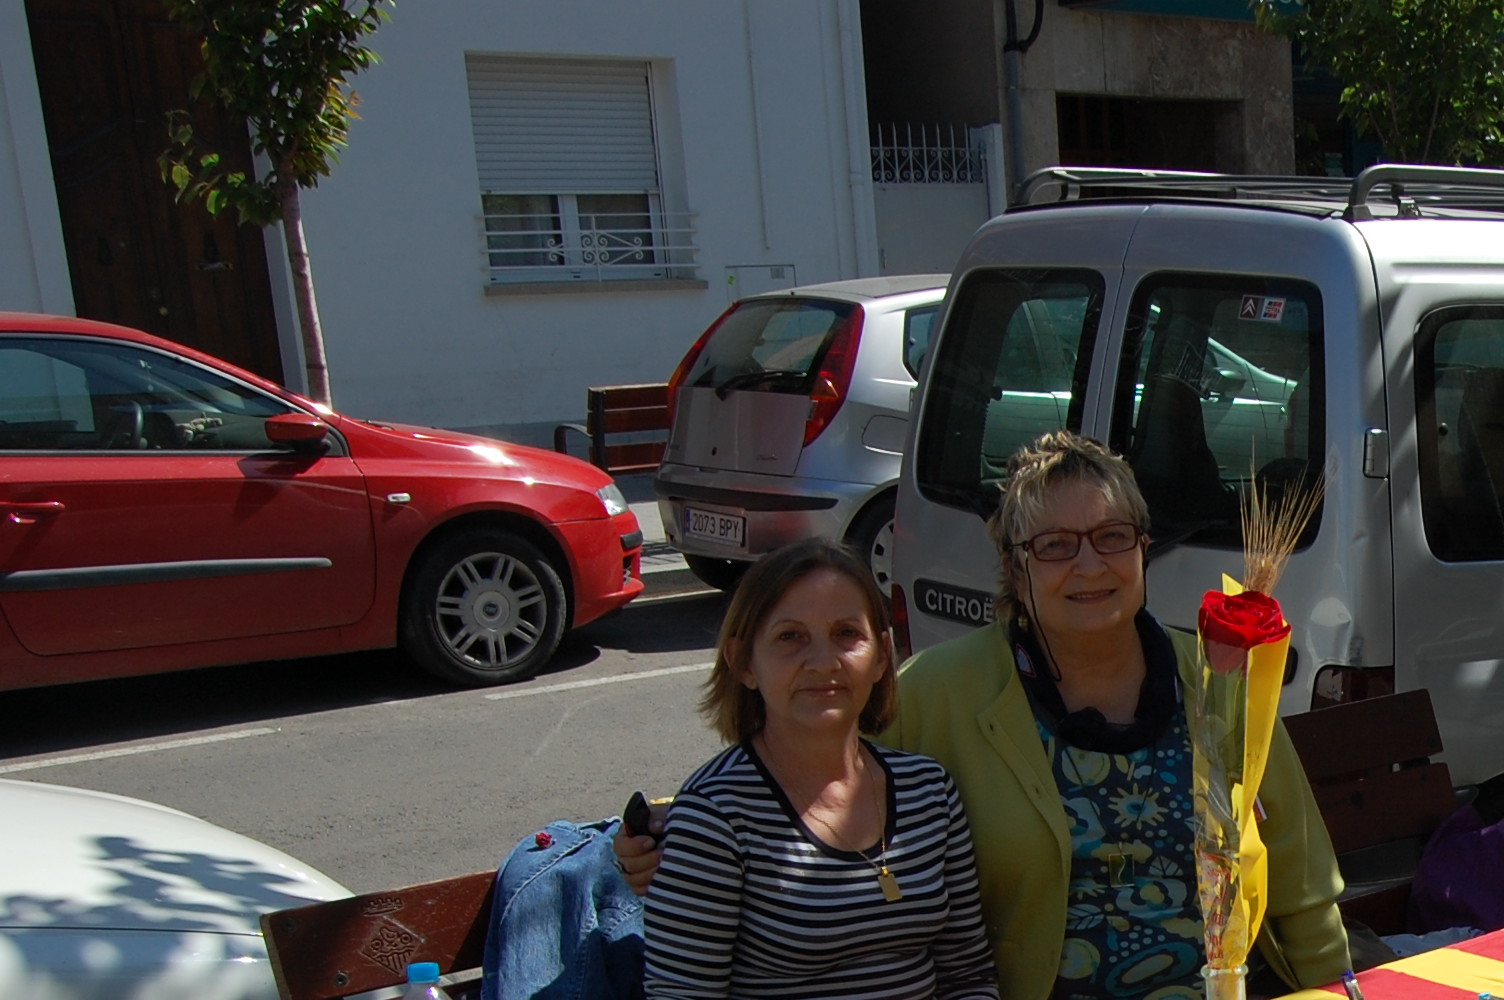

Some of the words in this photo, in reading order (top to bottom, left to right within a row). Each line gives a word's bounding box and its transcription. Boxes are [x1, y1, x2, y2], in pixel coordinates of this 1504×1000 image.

[692, 513, 716, 536] 2073
[719, 517, 740, 540] BPY
[925, 588, 994, 623] CITROË
